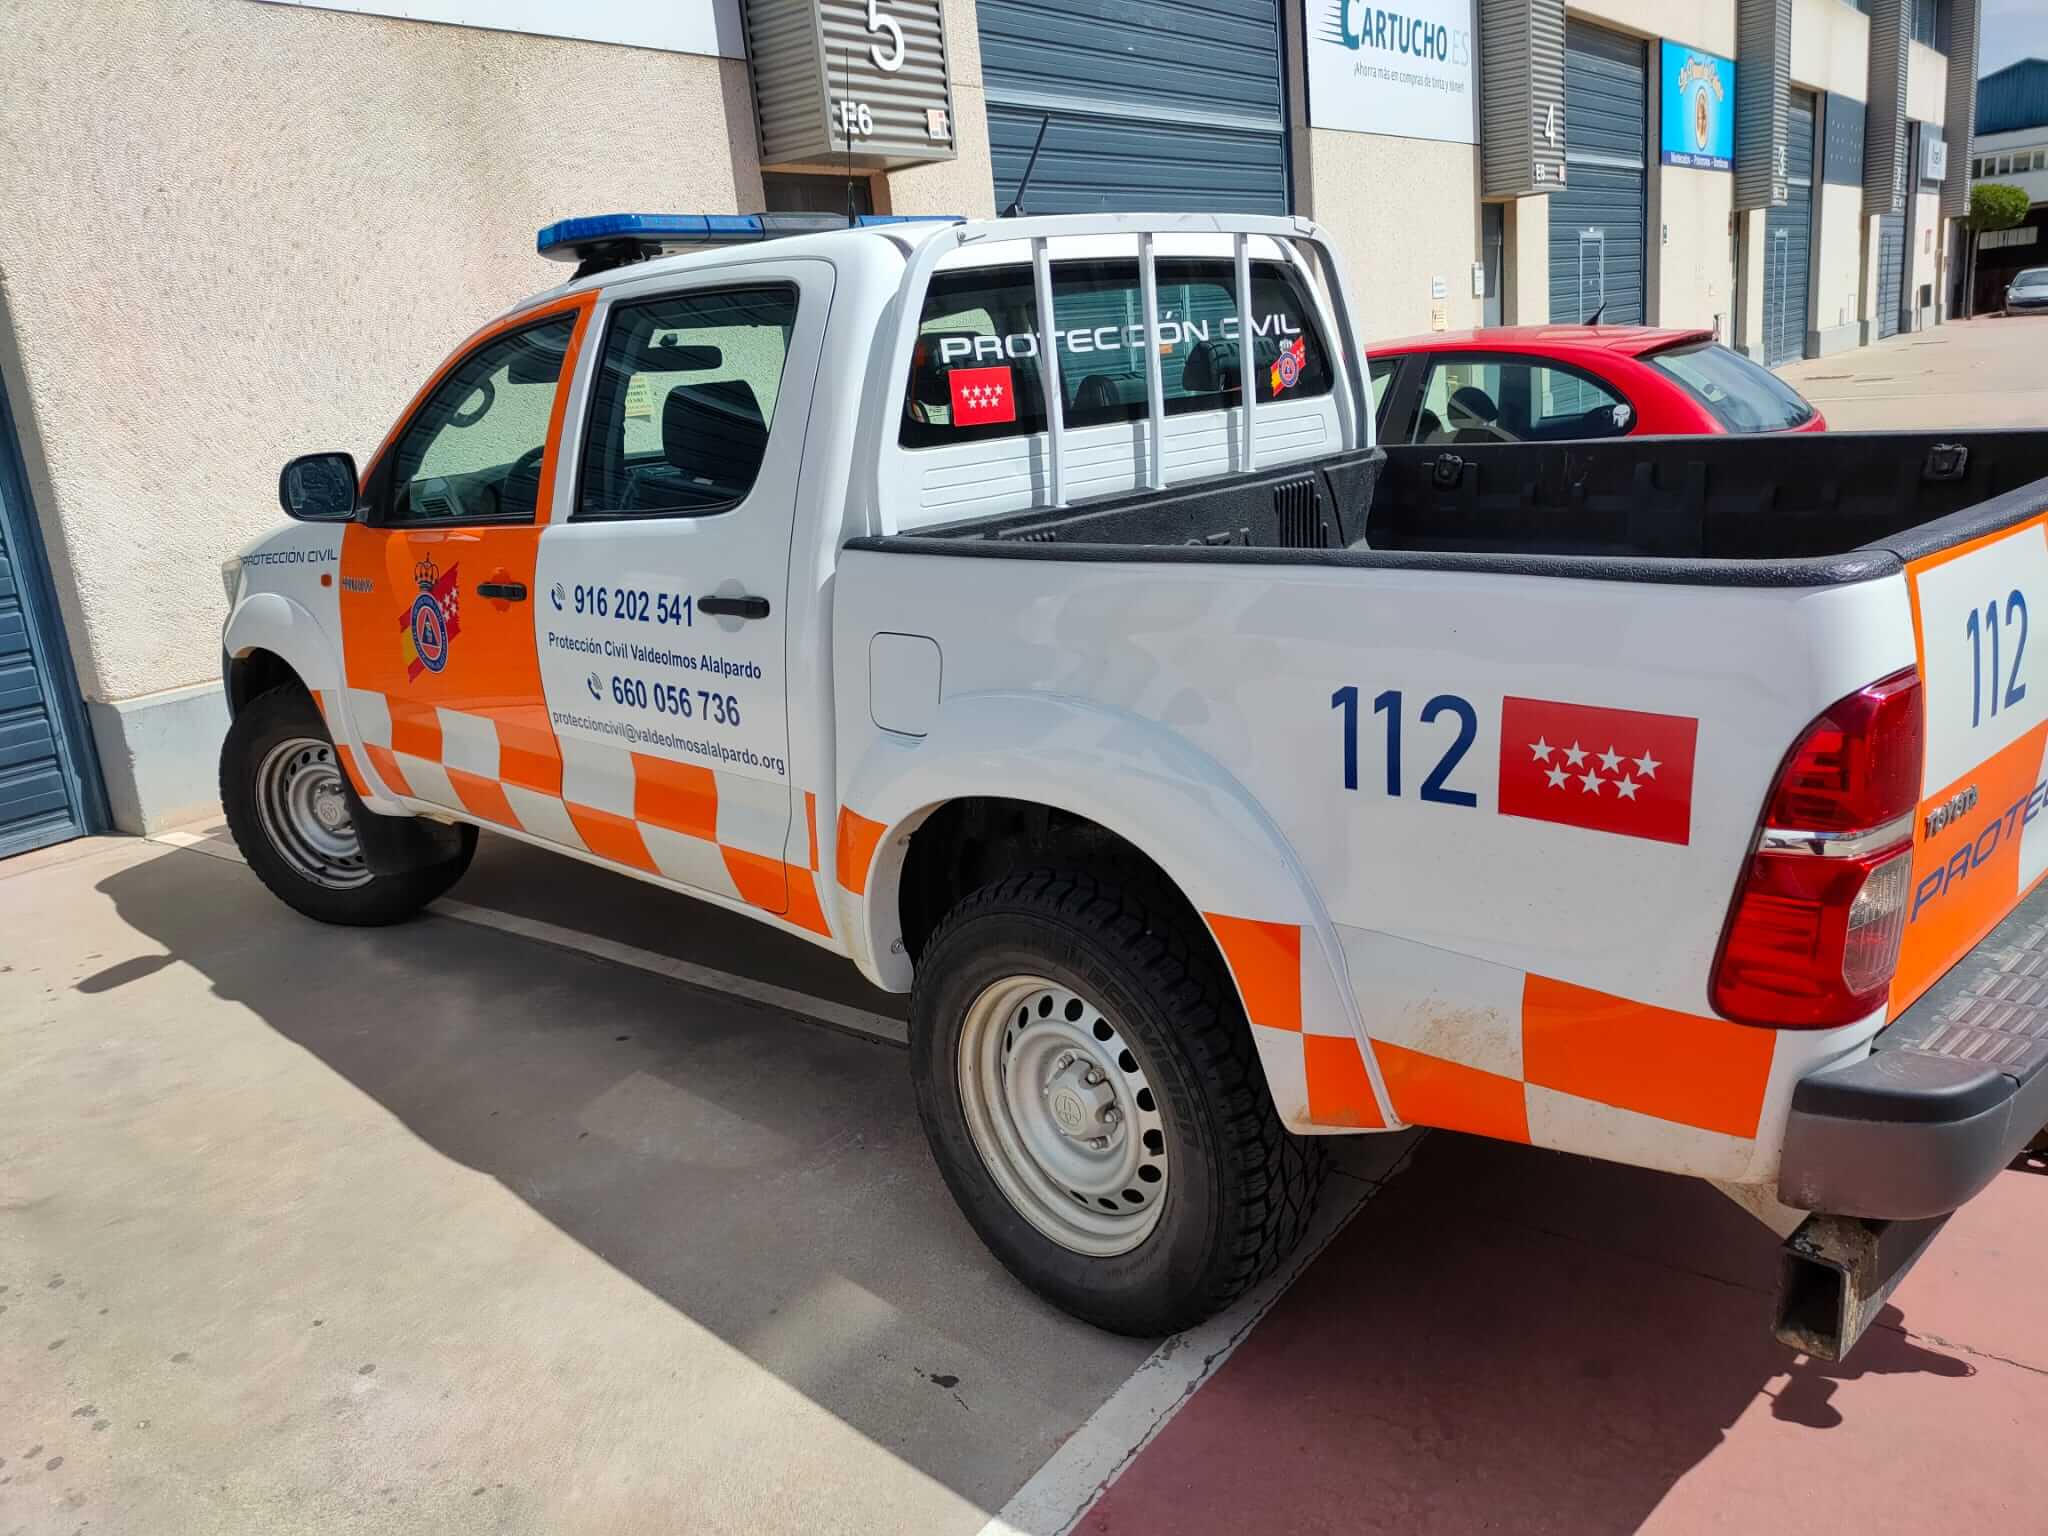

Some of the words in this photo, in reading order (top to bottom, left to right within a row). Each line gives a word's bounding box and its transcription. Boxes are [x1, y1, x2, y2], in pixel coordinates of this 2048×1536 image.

[868, 0, 905, 71] 5
[840, 101, 873, 135] E6
[1545, 103, 1556, 148] 4
[940, 311, 1209, 364] PROECCÓN
[1220, 313, 1300, 339] CVIL
[307, 548, 338, 562] CIVIL
[574, 585, 608, 617] 916
[614, 588, 650, 622] 202
[657, 593, 693, 627] 541
[548, 632, 602, 655] Protección
[604, 641, 628, 660] Civil
[630, 644, 697, 670] Valdeolmos
[700, 655, 762, 680] Alalpardo
[1966, 589, 2028, 728] 112
[612, 676, 647, 710] 660
[653, 683, 693, 718] 056
[698, 691, 741, 727] 736
[552, 711, 785, 775] proteccioncivil@valdeolmosalalpardo.org
[1331, 686, 1478, 808] 112
